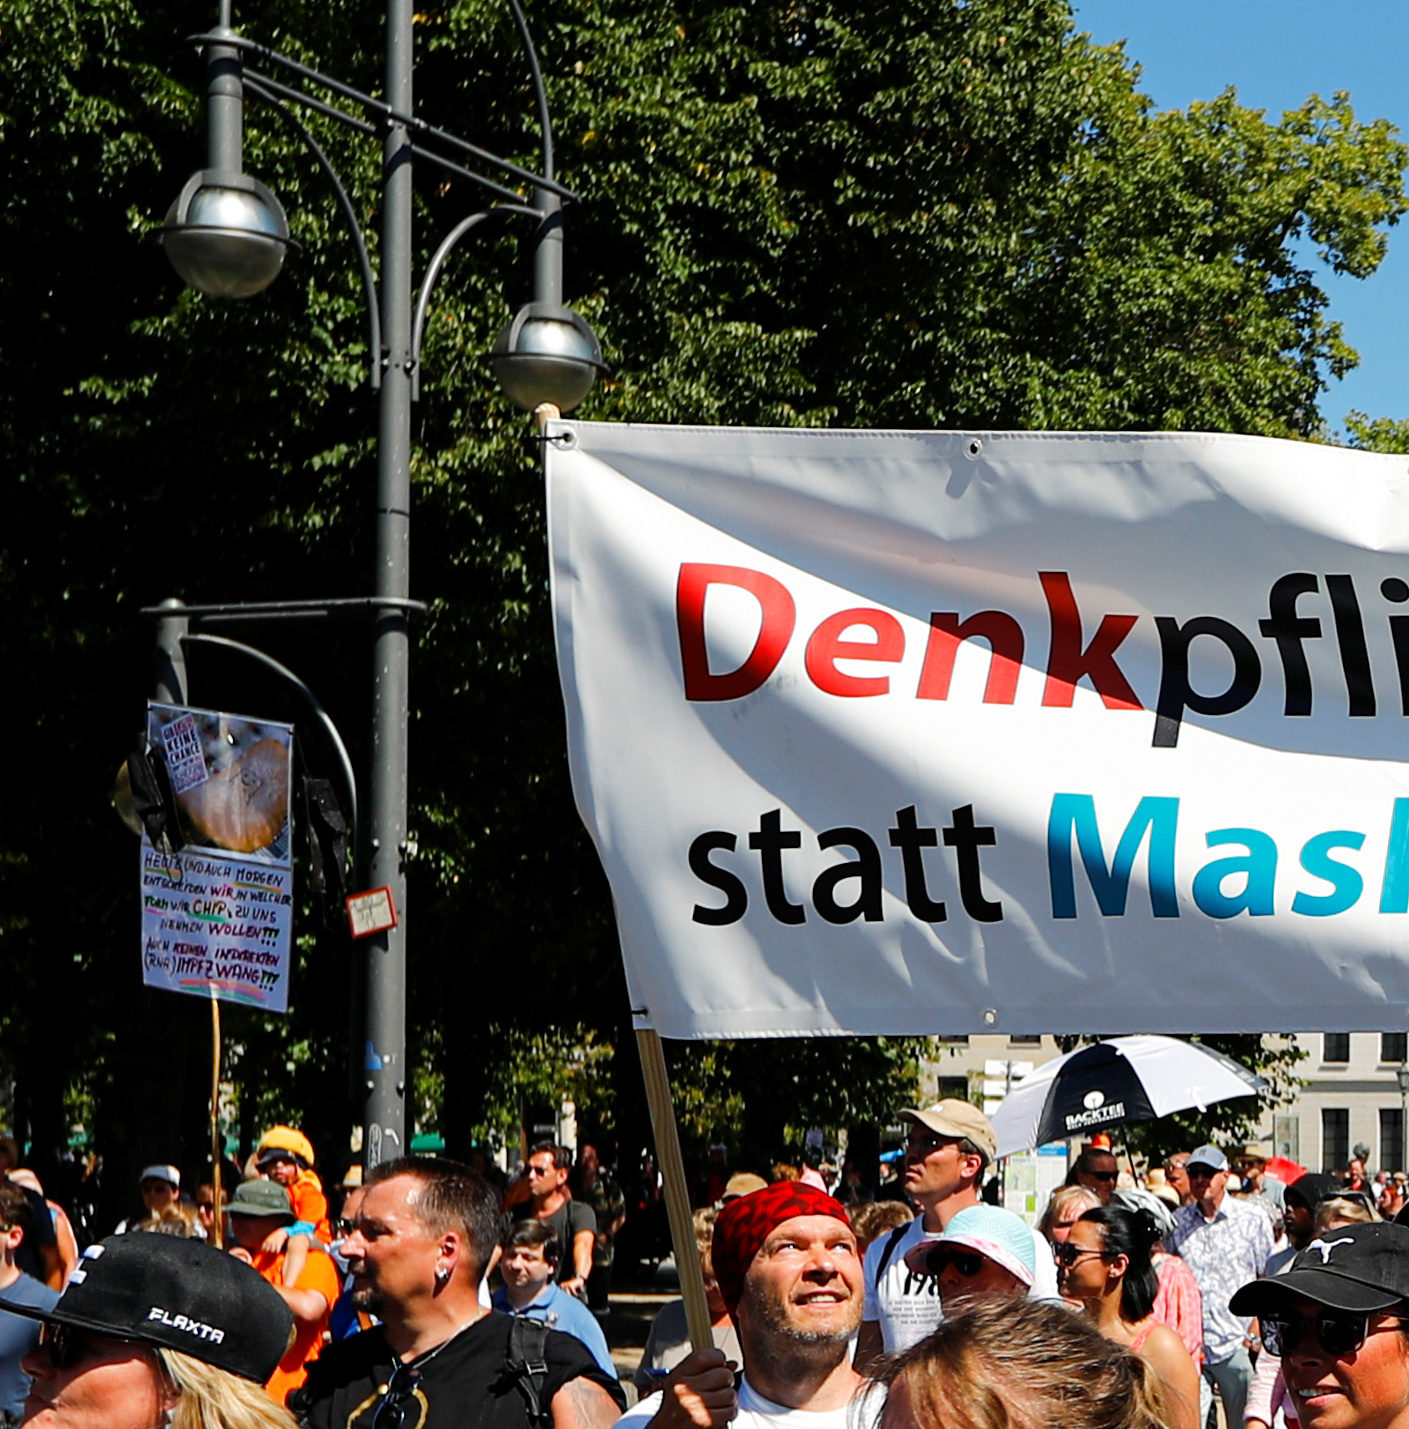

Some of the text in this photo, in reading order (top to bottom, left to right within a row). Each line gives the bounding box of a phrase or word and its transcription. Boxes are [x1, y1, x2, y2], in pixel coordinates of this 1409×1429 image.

[167, 729, 197, 752] KEINE
[170, 741, 200, 765] CHANCE
[688, 804, 1004, 926] statt
[235, 868, 285, 887] MORGEN
[235, 904, 250, 918] ZU
[252, 907, 278, 924] UNS
[160, 918, 204, 934] NEHMEN
[146, 936, 171, 951] AUCH
[173, 941, 209, 958] KEINEN
[1065, 1102, 1125, 1125] BACKTEE
[902, 1270, 940, 1297] 198
[149, 1306, 226, 1345] FLAXTA
